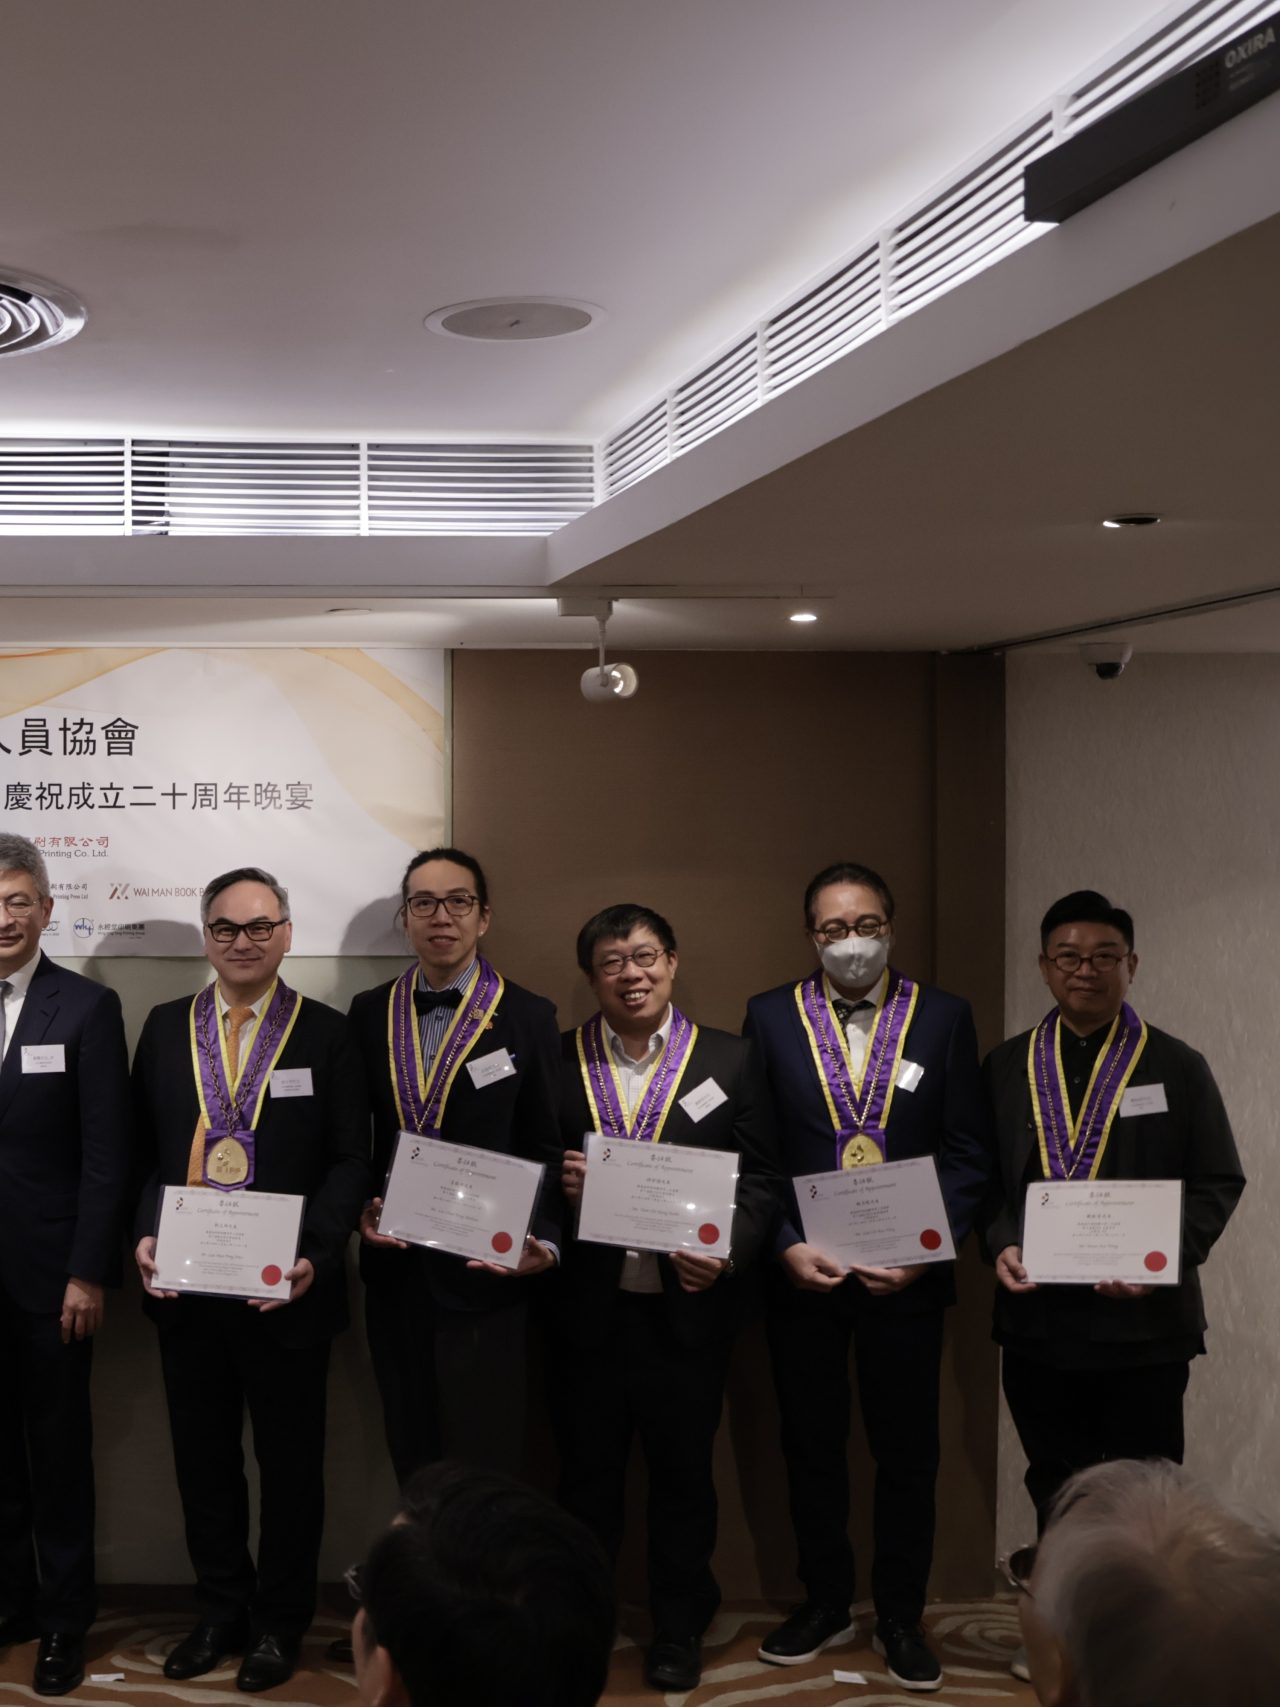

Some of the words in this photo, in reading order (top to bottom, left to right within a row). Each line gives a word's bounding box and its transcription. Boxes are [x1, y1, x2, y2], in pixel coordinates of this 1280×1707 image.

[1225, 27, 1276, 68] OXIRA
[4, 781, 315, 811] 慶祝成立二十周年晚宴
[40, 850, 72, 859] Printing
[133, 888, 149, 896] WAI
[151, 888, 173, 896] MAN
[175, 888, 197, 896] BOOK
